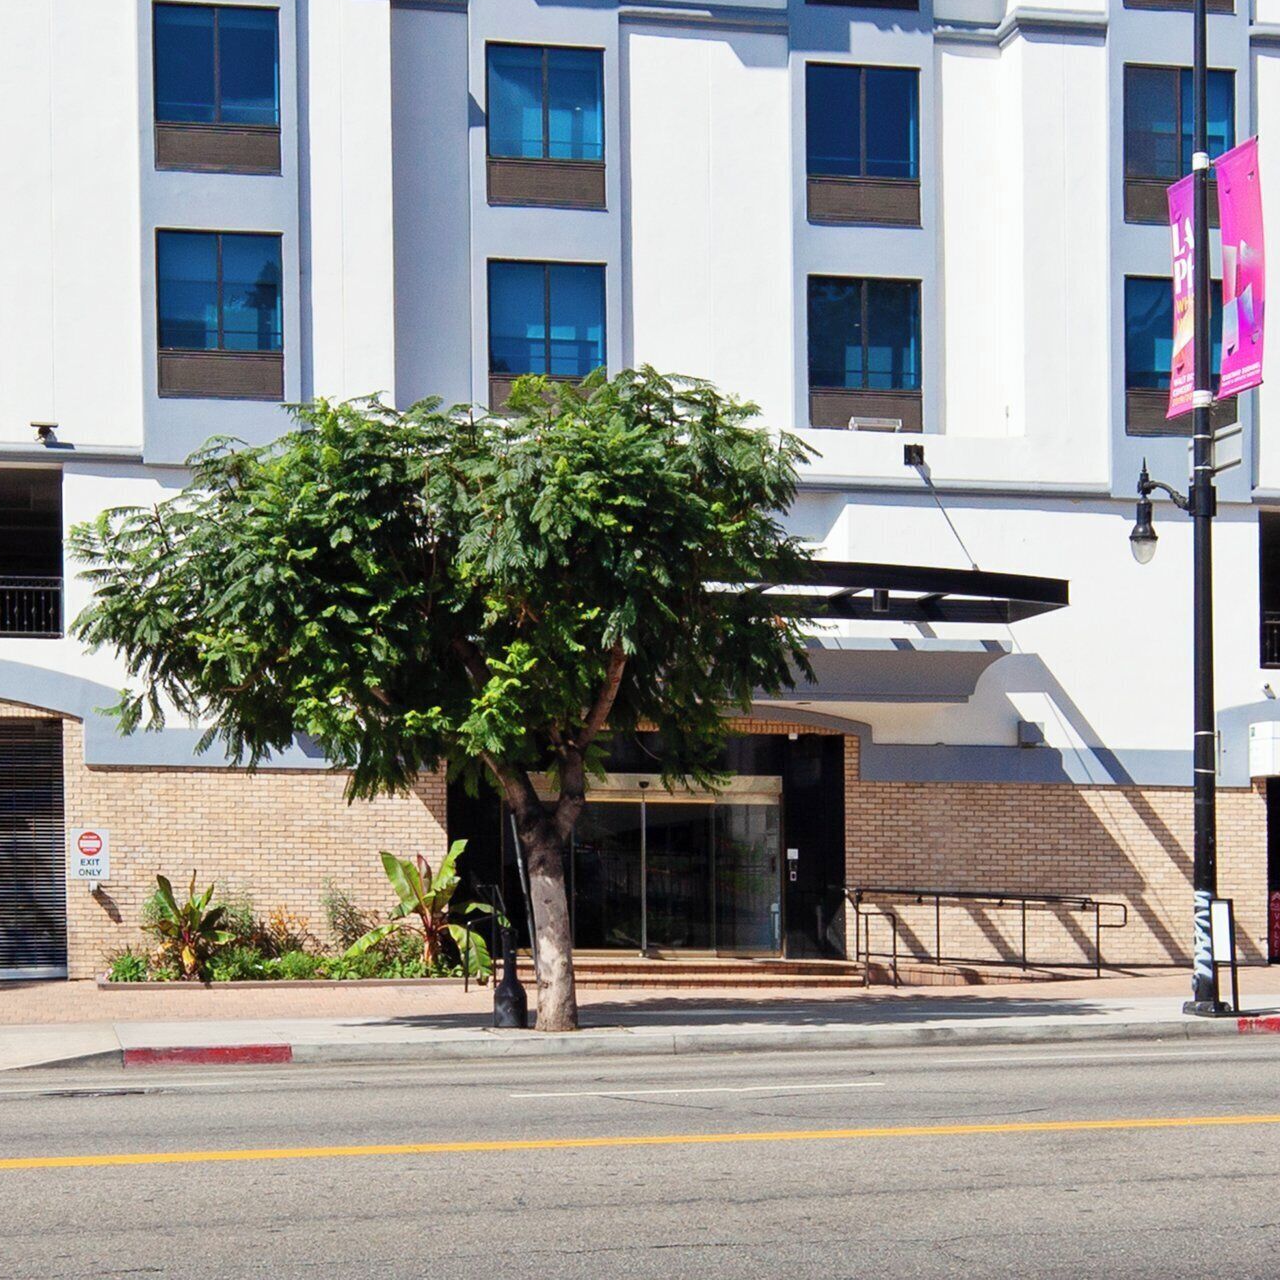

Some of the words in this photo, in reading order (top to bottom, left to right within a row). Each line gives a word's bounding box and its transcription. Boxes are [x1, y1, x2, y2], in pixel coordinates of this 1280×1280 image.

[80, 858, 100, 866] EXIT
[78, 868, 102, 877] ONLY
[1273, 912, 1280, 957] VALET
